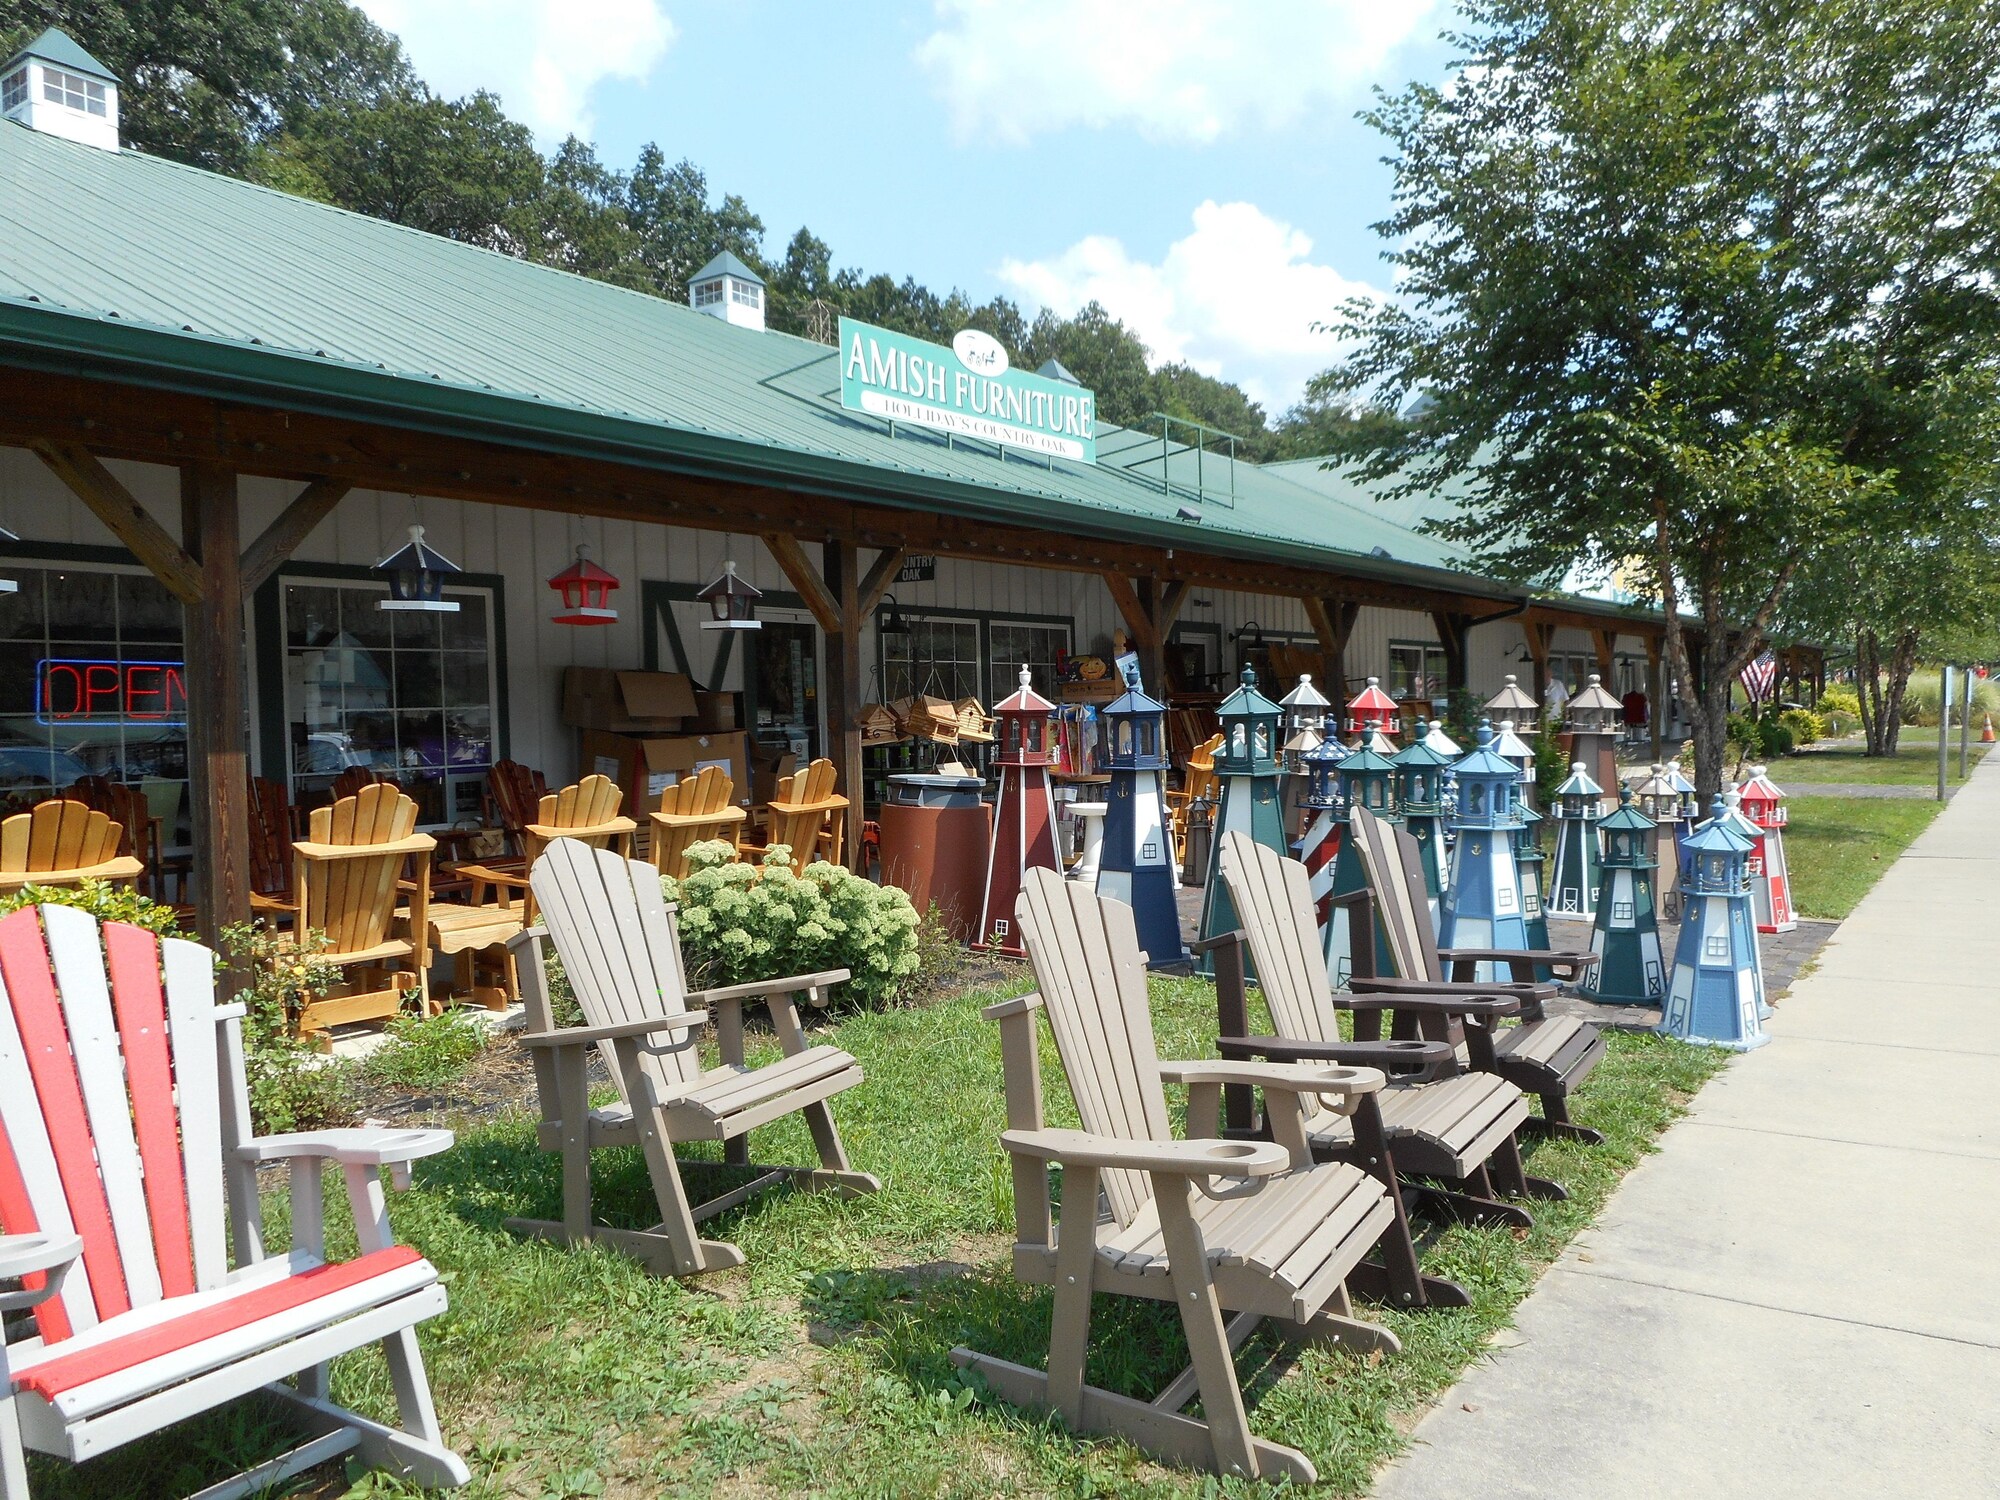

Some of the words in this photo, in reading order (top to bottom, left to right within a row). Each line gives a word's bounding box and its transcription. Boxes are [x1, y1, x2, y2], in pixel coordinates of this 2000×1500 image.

[847, 332, 947, 404] AMISH
[955, 371, 1093, 440] FURNITURE
[885, 400, 970, 430] HOLLIDAY'S
[974, 421, 1037, 446] COUNTRY
[1042, 438, 1066, 453] OAK
[902, 568, 921, 581] OAK
[44, 665, 187, 718] OPEN
